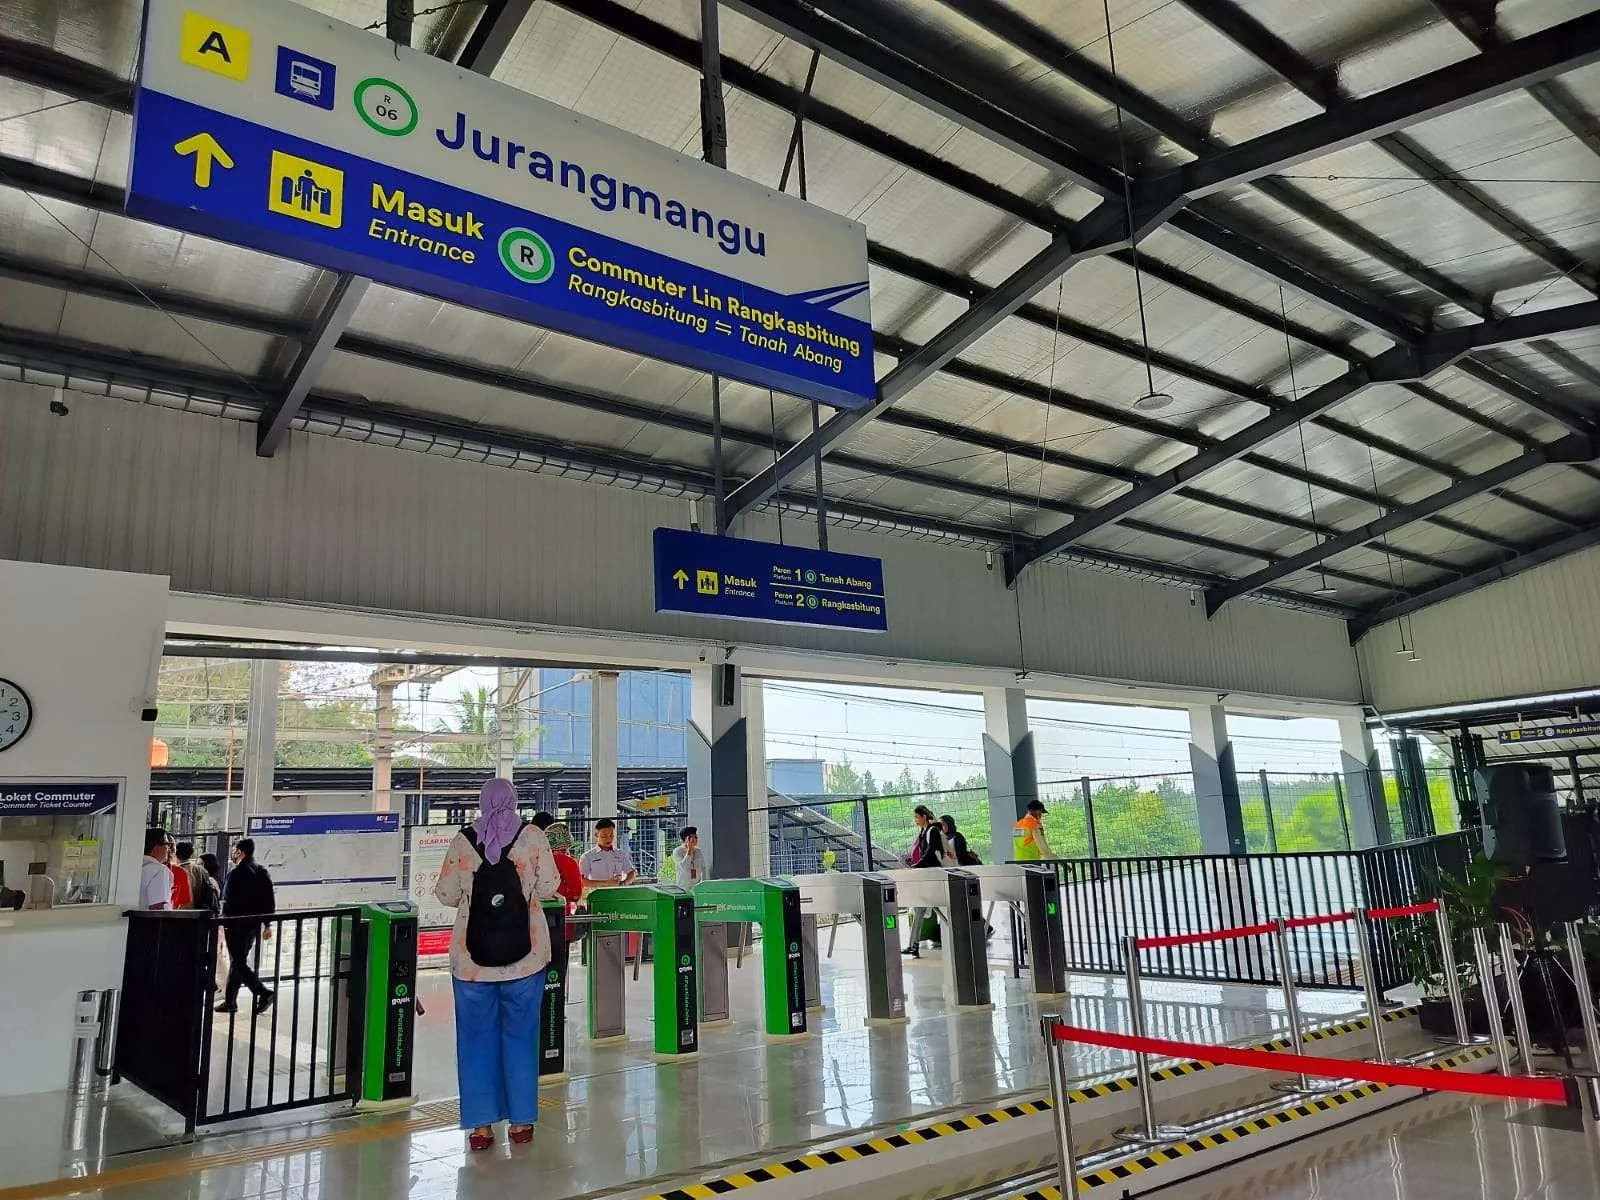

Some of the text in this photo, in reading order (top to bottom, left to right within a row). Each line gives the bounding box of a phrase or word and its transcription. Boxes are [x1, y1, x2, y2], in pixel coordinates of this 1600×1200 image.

[199, 31, 232, 63] A
[383, 94, 391, 104] R
[375, 104, 399, 121] 06
[435, 111, 766, 257] Jurangmangu
[371, 182, 485, 241] Masuk
[367, 217, 477, 265] Entrance
[519, 245, 535, 267] R
[567, 246, 862, 357] Commuter Lin Rangkasbitung
[567, 274, 843, 374] Rangkasbitung Tanah Abang
[724, 574, 758, 589] Masuk
[795, 568, 801, 582] 1
[819, 573, 844, 585] Tanah
[846, 577, 872, 590] Abang
[724, 587, 756, 598] Entrance
[796, 593, 805, 607] 2
[821, 598, 881, 615] Rangkasbitung
[9, 697, 19, 707] 2
[12, 711, 21, 721] 3
[5, 724, 15, 734] 4
[1537, 729, 1544, 737] 2
[0, 792, 96, 802] Loket Commuter
[544, 982, 561, 990] gojek
[391, 997, 411, 1006] gojek
